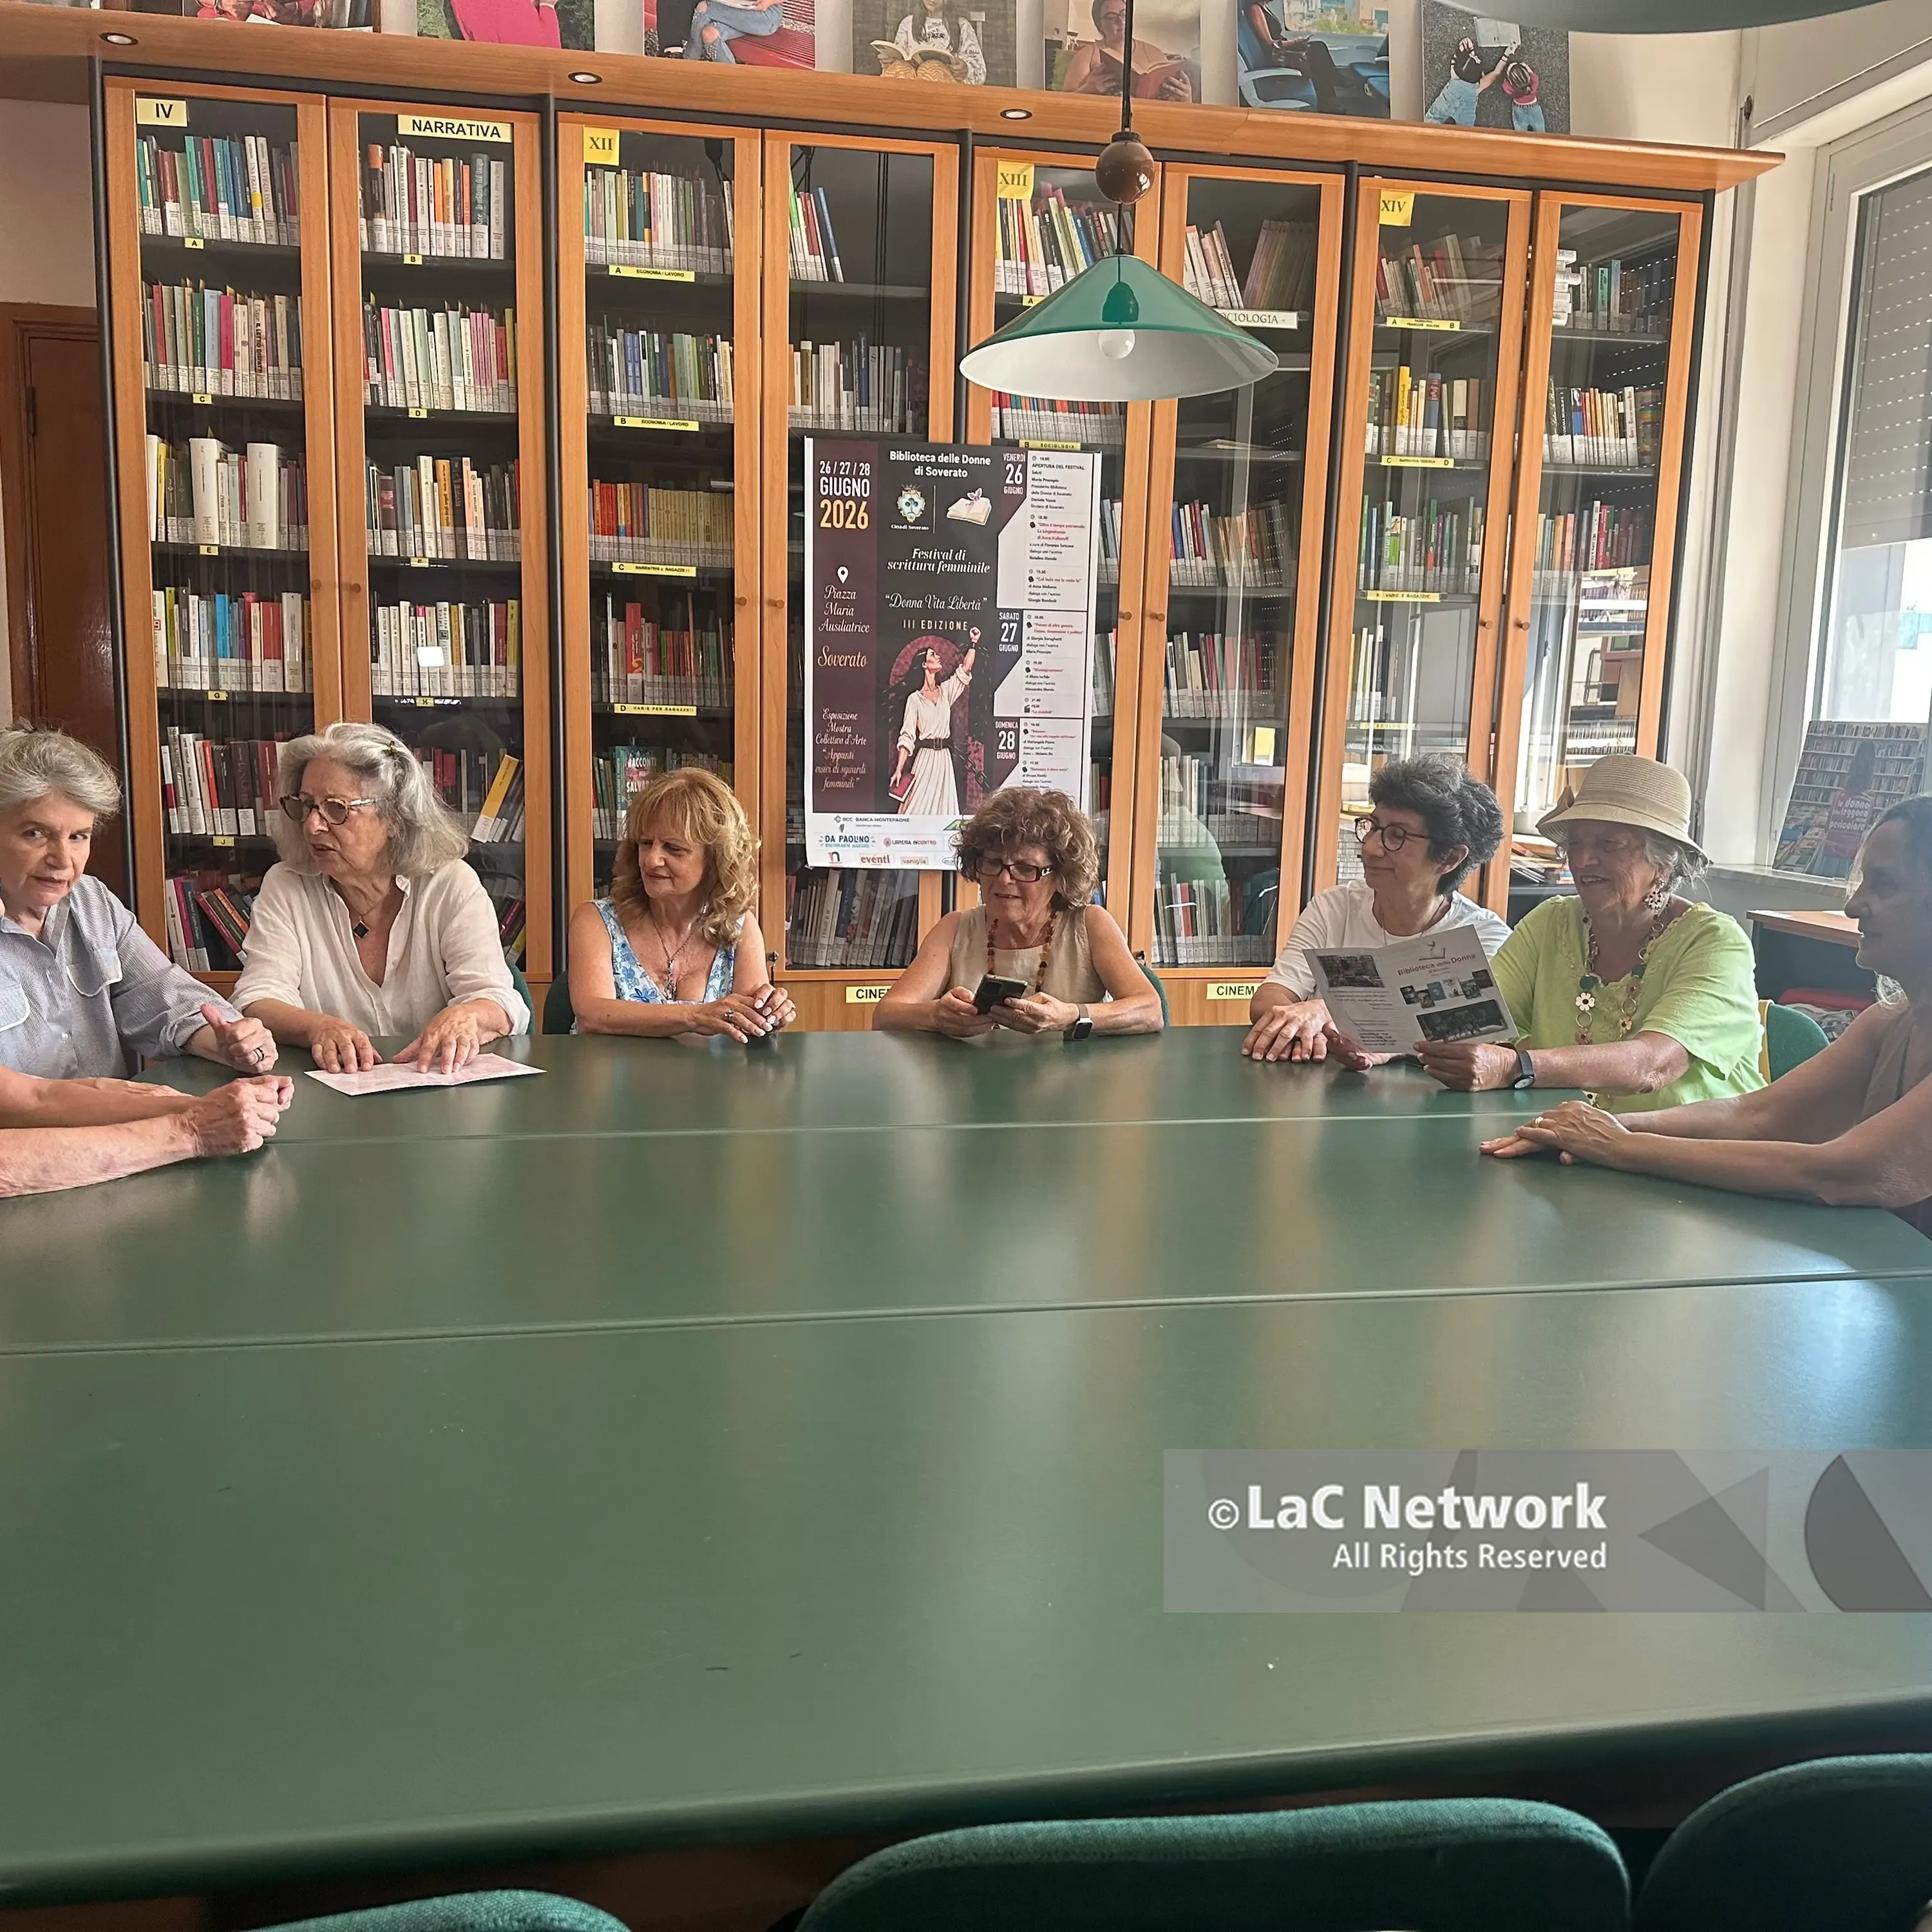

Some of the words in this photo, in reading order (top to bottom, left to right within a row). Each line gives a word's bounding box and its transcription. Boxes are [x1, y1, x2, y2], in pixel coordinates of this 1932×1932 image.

[155, 103, 173, 118] IV
[412, 119, 501, 138] NARRATIVA
[589, 137, 613, 151] XII
[999, 172, 1028, 187] XIII
[1381, 199, 1406, 213] XIV
[1220, 312, 1278, 324] OCIOLOGIA
[889, 451, 936, 463] Biblioteca
[938, 453, 960, 464] delle
[961, 455, 991, 466] Donne
[1003, 452, 1026, 462] VENERDÌ
[819, 460, 831, 474] 26
[839, 462, 851, 475] 27
[858, 462, 871, 477] 28
[914, 466, 923, 477] di
[925, 467, 968, 478] Soverato
[1005, 463, 1023, 485] 26
[819, 477, 870, 498] GIUGNO
[1003, 486, 1023, 495] GIUGNO
[820, 499, 869, 530] 2026
[912, 548, 953, 561] Festival
[954, 549, 966, 561] di
[887, 560, 935, 572] scrittura
[936, 562, 990, 574] femminile
[824, 585, 857, 600] Piazza
[925, 594, 945, 609] Vita
[824, 602, 855, 616] Maria
[999, 612, 1019, 621] SABATO
[818, 618, 870, 633] Ausiliatrice
[903, 620, 915, 629] III
[921, 620, 968, 631] EDIZIONE
[1001, 622, 1018, 643] 27
[999, 643, 1019, 652] GIUGNO
[817, 645, 868, 668] Soverato
[822, 708, 858, 723] Esposizione
[826, 722, 852, 733] Mostra
[995, 721, 1019, 729] DOMENICA
[844, 734, 867, 745] d'Arte
[998, 730, 1016, 750] 28
[627, 757, 657, 769] RACCONTI
[996, 752, 1016, 760] GIUGNO
[1844, 797, 1870, 810] donne
[1840, 806, 1868, 819] leggono
[1397, 963, 1435, 976] Biblioteca
[1450, 954, 1476, 964] Donne
[856, 989, 886, 999] CINE
[1217, 985, 1255, 996] CINEM
